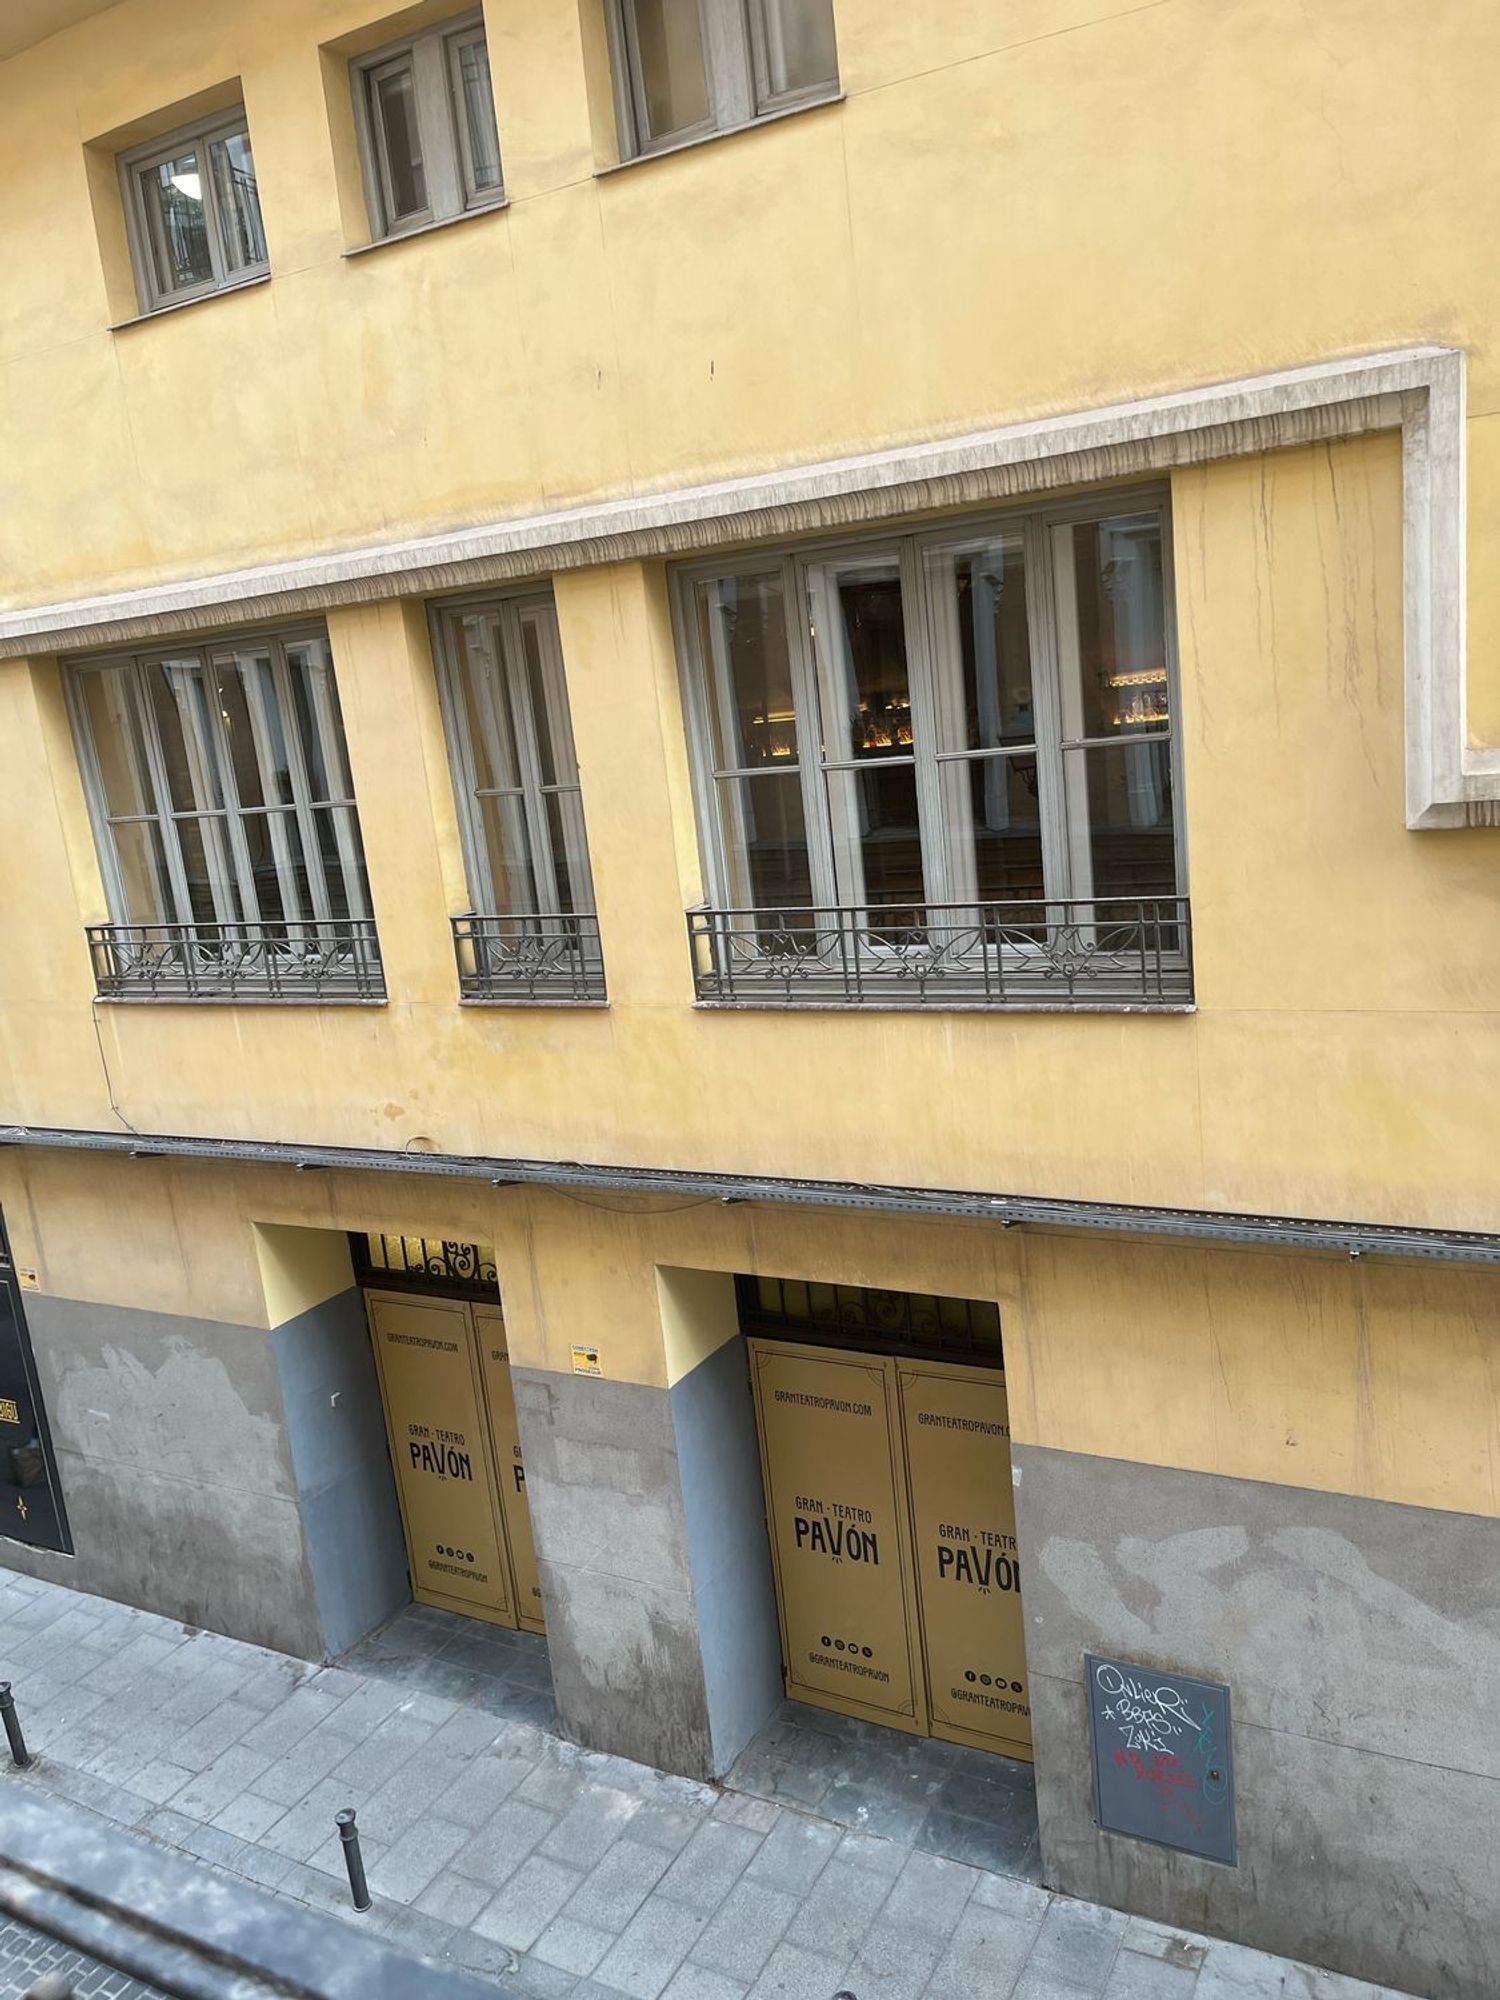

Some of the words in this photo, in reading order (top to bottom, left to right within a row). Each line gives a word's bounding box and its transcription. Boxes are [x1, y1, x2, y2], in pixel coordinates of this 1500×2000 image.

[774, 1390, 872, 1416] GRANTEATROPAVON.COM
[408, 1423, 430, 1438] GRAN
[435, 1429, 465, 1446] TEATRO
[409, 1441, 473, 1481] PAVÓN
[795, 1495, 824, 1513] GRAN
[832, 1504, 872, 1524] TEATRO
[794, 1516, 879, 1565] PAVÓN
[939, 1523, 971, 1542] GRAN
[809, 1651, 889, 1683] @GRANTEATROPAVON
